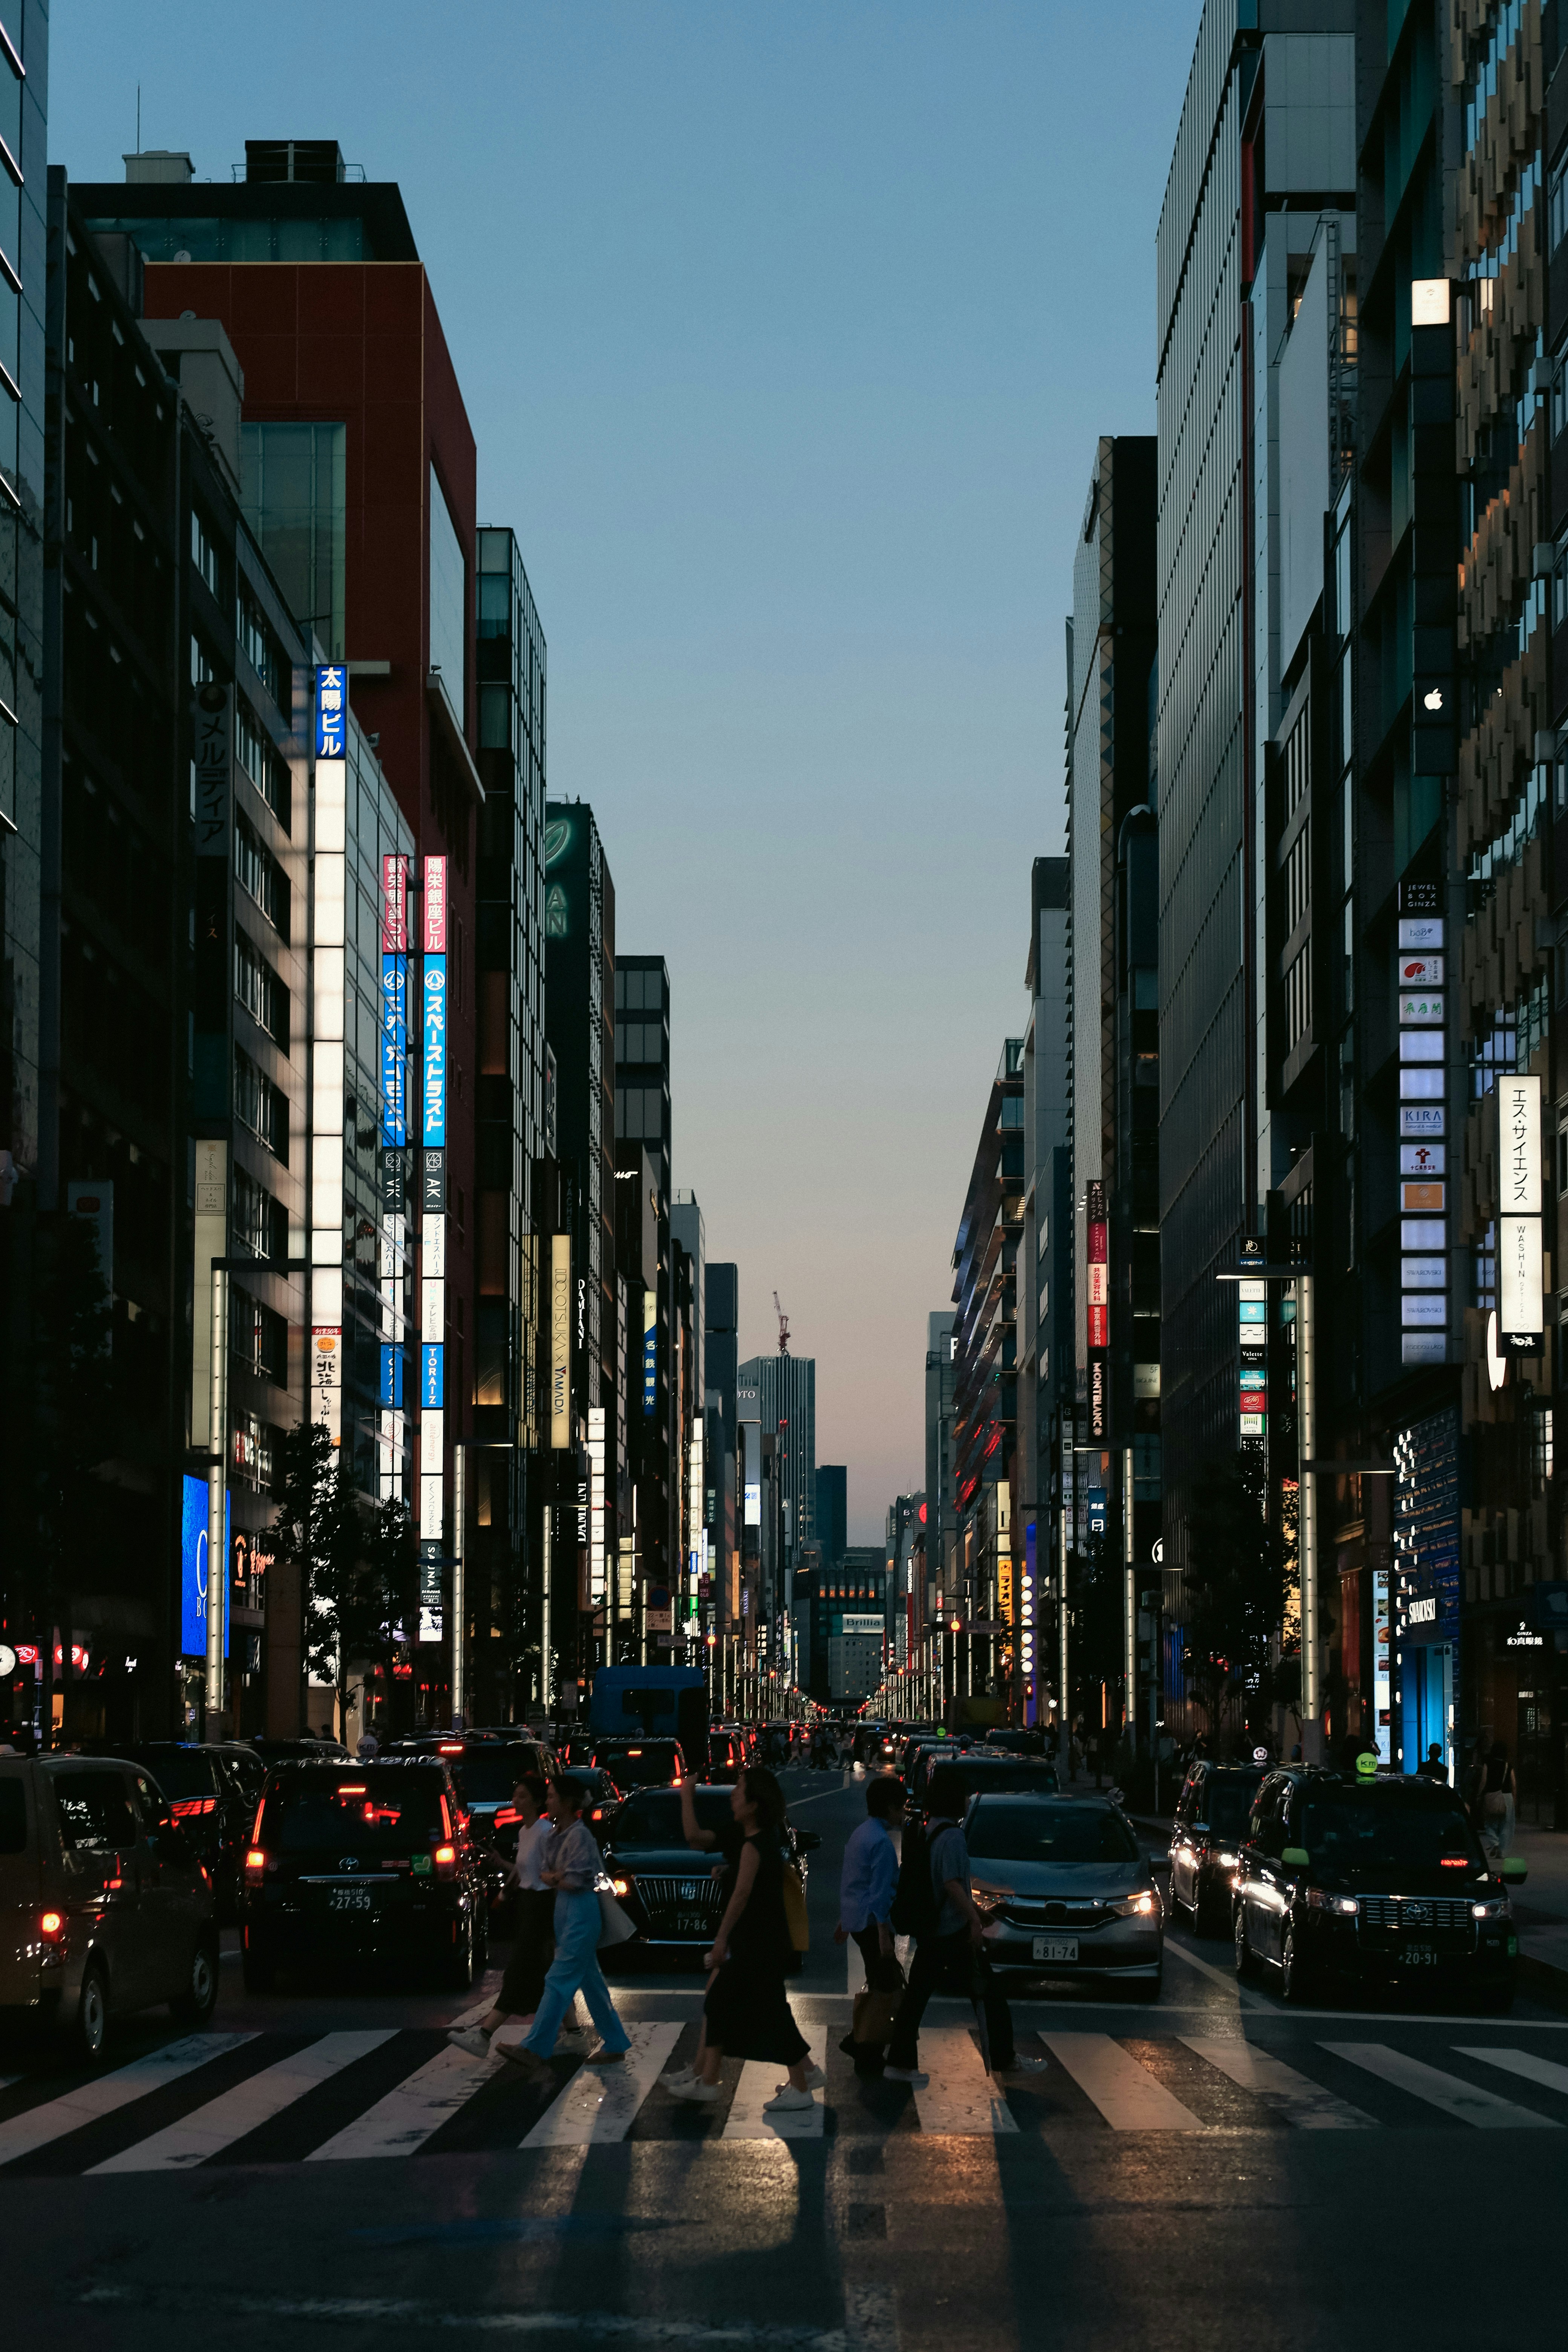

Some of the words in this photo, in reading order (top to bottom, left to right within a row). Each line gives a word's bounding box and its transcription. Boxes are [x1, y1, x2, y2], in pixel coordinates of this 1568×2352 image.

[320, 666, 343, 756] 太陽ビル
[200, 716, 225, 843] メルディア
[427, 858, 443, 950] 陽栄銀座ビル
[426, 996, 445, 1132] スペーストラスト
[1406, 1111, 1441, 1121] KIRA
[1512, 1090, 1528, 1200] エス・サイエンス
[426, 1178, 441, 1198] AK
[1517, 1226, 1526, 1277] WASHIN
[555, 1294, 568, 1351] OTSUKA
[428, 1348, 438, 1404] TORAIZ
[554, 1365, 567, 1415] YAMADA
[645, 1340, 655, 1406] 名鉄観光
[1093, 1362, 1102, 1427] MONTBLANC
[1409, 1598, 1436, 1624] SWAROVSKI
[337, 1896, 371, 1909] 27-59
[677, 1919, 707, 1930] 17-86
[1043, 1946, 1075, 1958] 81-74
[1405, 1952, 1437, 1965] 20-91
